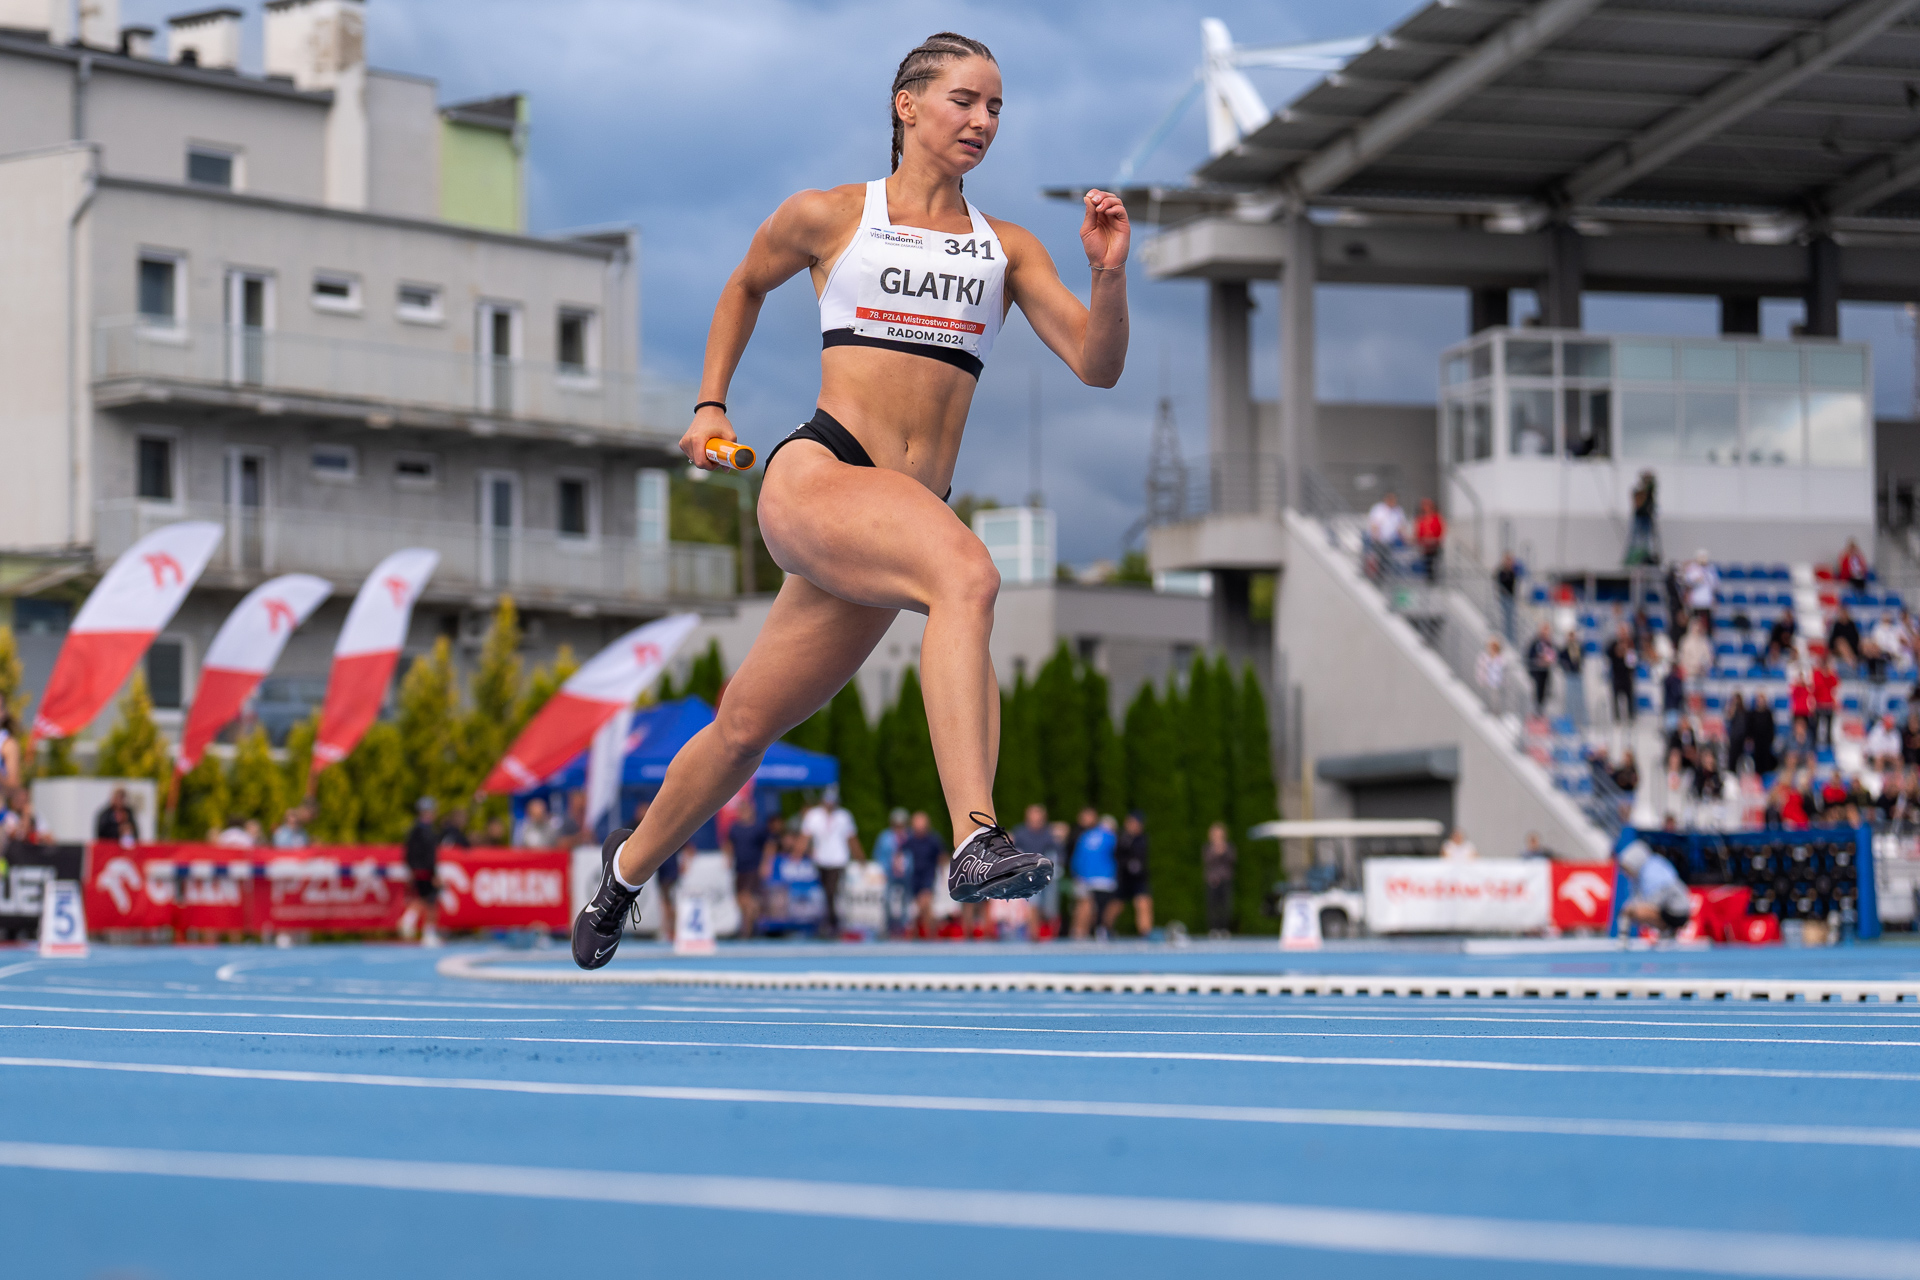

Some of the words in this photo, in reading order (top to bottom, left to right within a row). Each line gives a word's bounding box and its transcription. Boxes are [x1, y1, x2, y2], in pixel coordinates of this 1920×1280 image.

[870, 231, 923, 245] visitRadom.pl
[944, 238, 995, 260] 341
[879, 267, 985, 306] GLATKI
[869, 310, 881, 319] 78.
[882, 312, 901, 322] PZLA
[902, 315, 949, 328] Mistrzostwa
[887, 326, 935, 342] RADOM
[937, 333, 964, 346] 2024
[54, 893, 76, 939] 5
